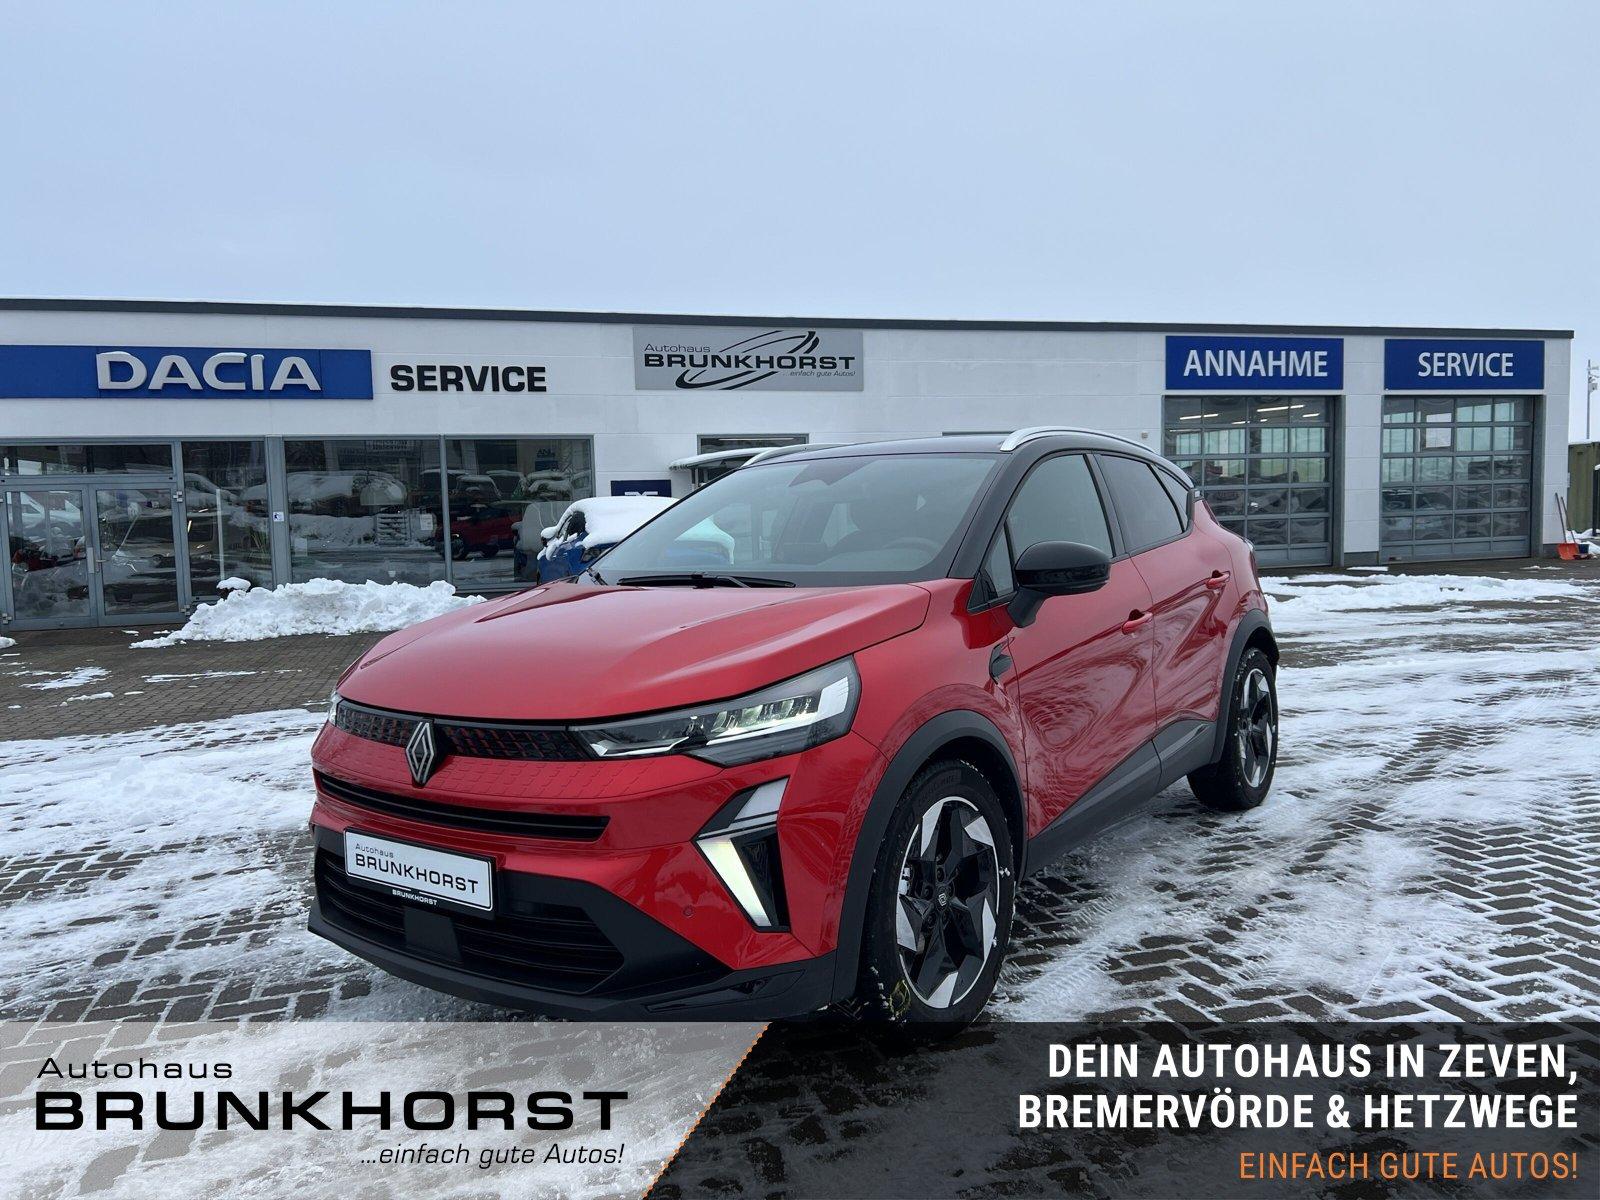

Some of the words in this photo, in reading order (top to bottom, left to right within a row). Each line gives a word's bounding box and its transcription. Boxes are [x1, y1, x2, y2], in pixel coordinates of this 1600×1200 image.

[644, 343, 711, 353] Autohaus
[96, 351, 322, 391] DACIA
[644, 353, 856, 370] BRUNKHORST
[1183, 349, 1328, 377] ANNAHME
[1418, 352, 1514, 377] SERVICE
[390, 364, 547, 393] SERVICE
[355, 843, 394, 858] Autohaus
[355, 853, 478, 894] BRUNKHORST
[392, 889, 438, 906] BRUNKHORST
